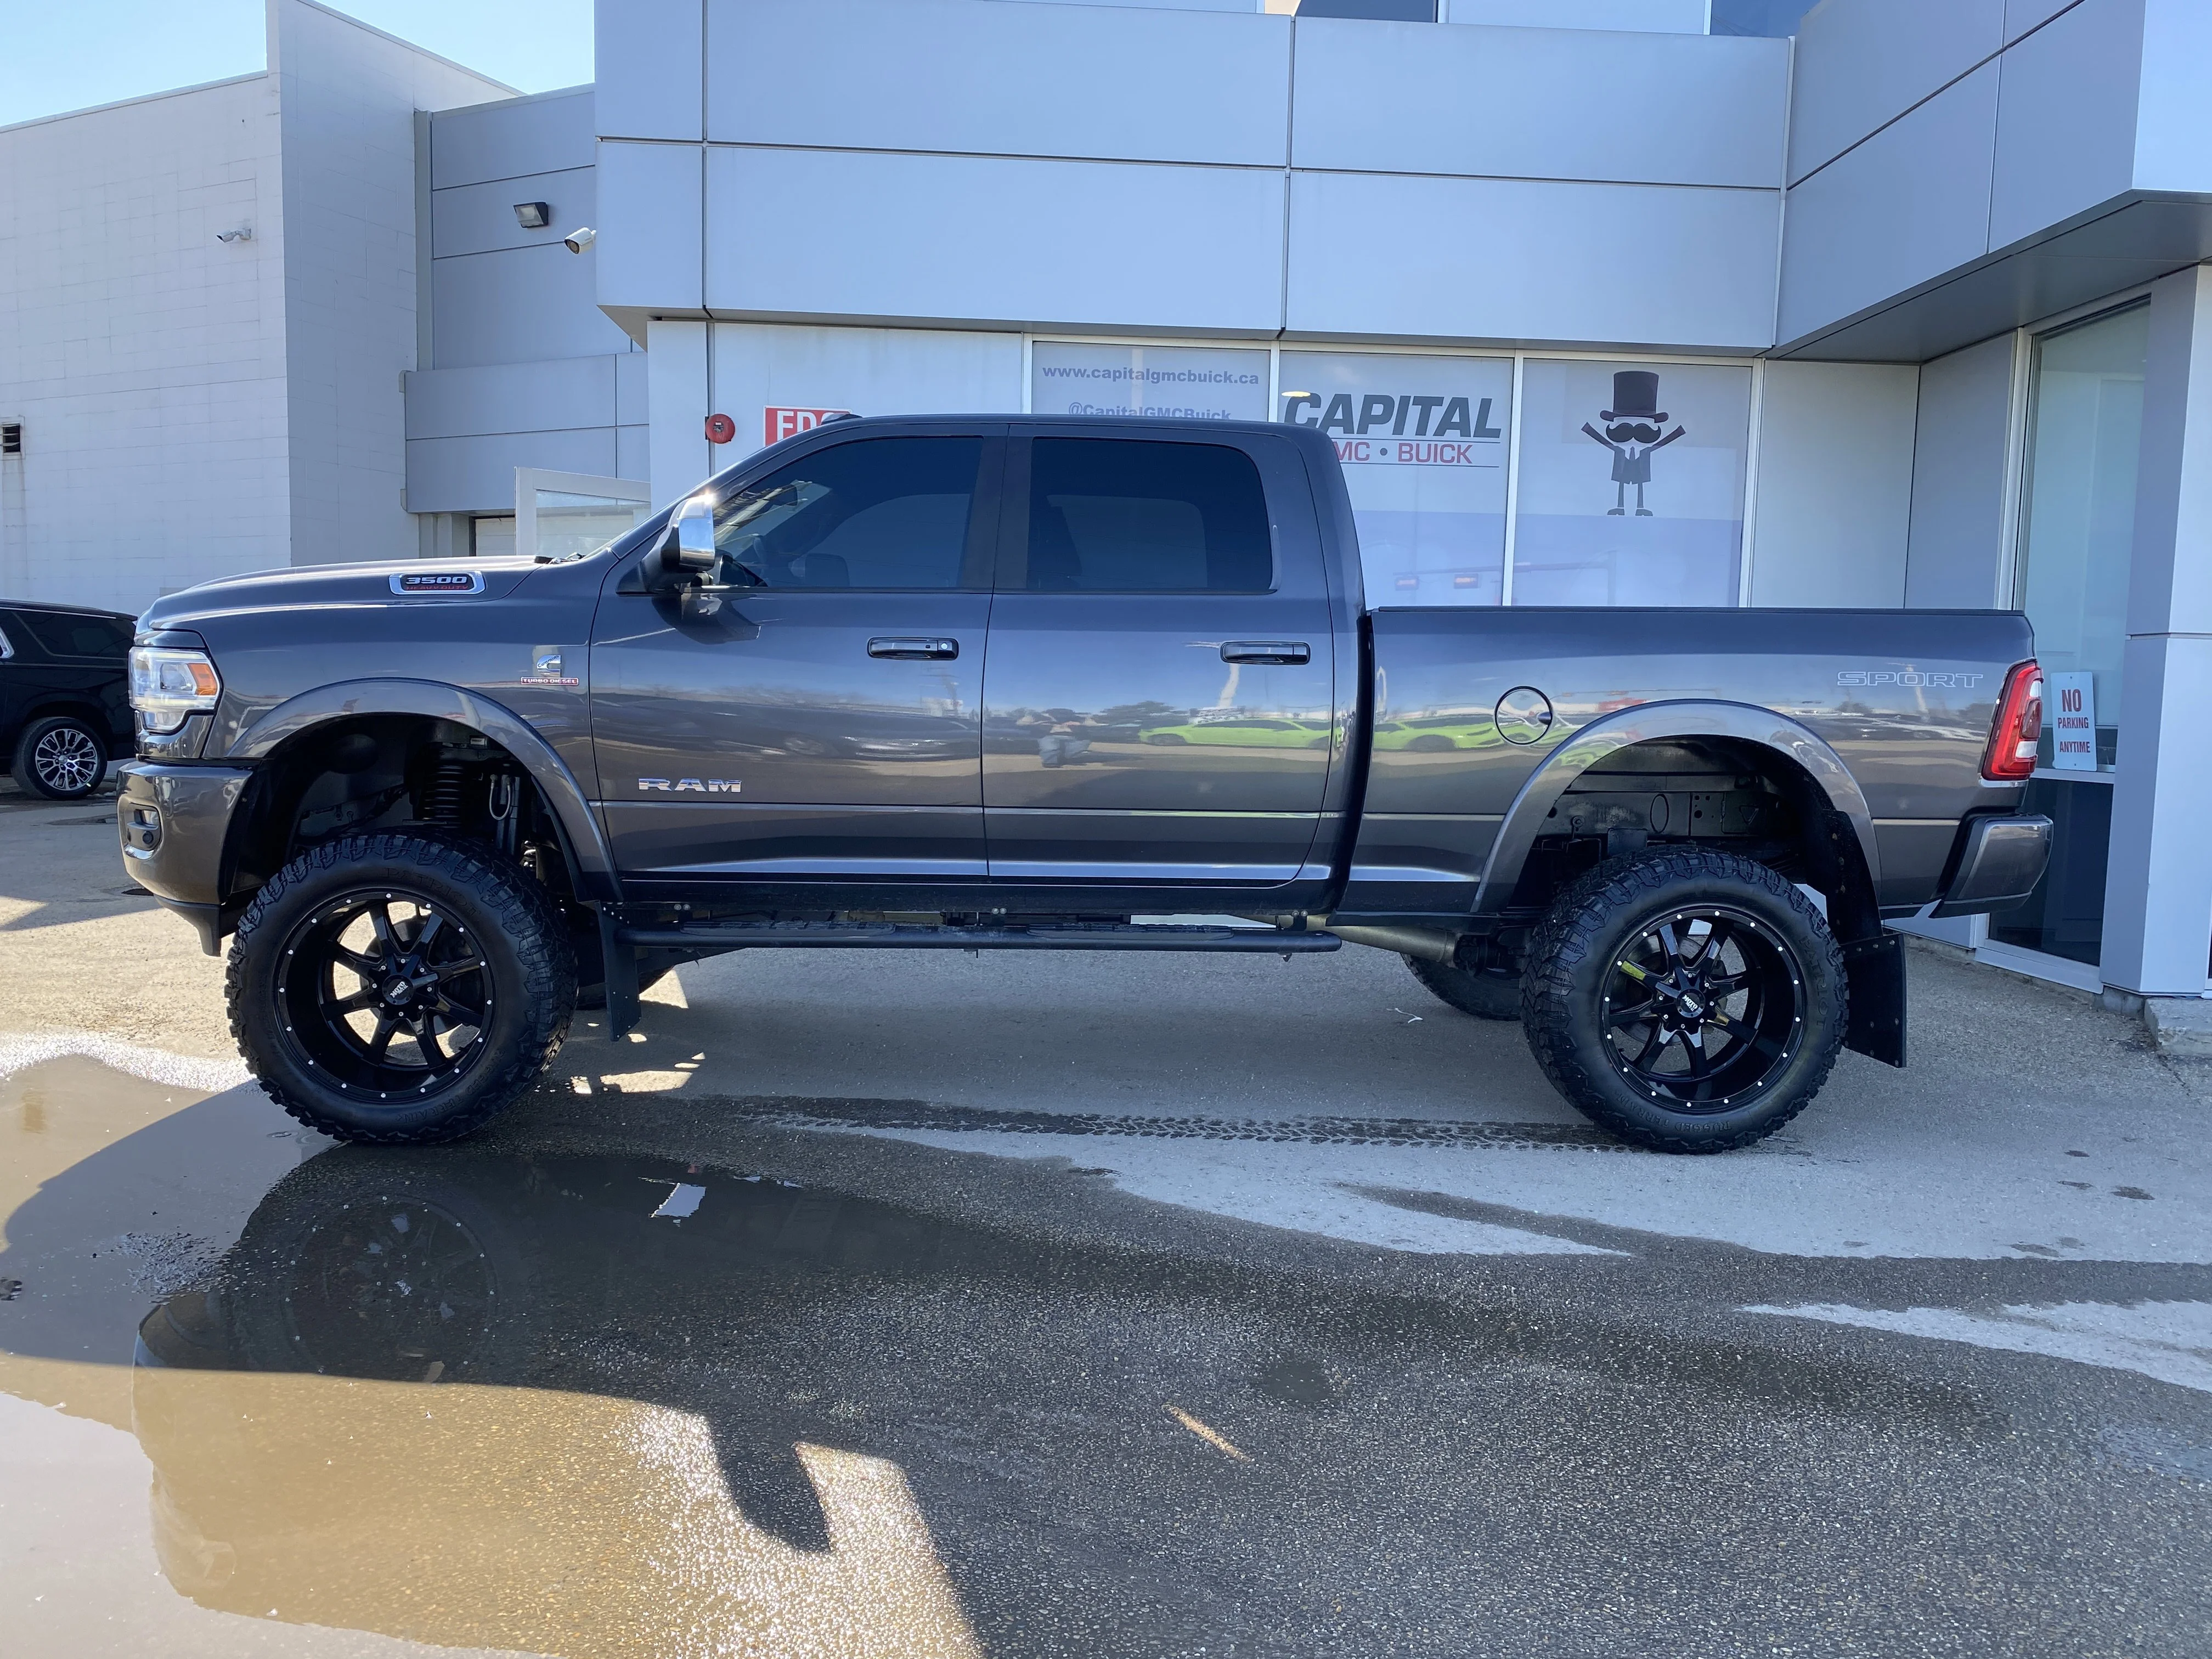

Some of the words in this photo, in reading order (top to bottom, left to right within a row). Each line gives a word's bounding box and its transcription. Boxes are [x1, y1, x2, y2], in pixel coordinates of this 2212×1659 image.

[1042, 367, 1259, 384] www.capitalgmcbuick.ca
[1284, 392, 1502, 438] CAPITAL
[777, 410, 834, 441] FD
[1333, 441, 1370, 461] MC
[1398, 443, 1472, 464] BUICK
[537, 654, 560, 668] Cummins
[1837, 672, 1984, 688] SPORT
[2062, 689, 2082, 712] NO
[2058, 717, 2089, 729] PARKING
[2059, 741, 2091, 753] ANYTIME
[638, 778, 742, 793] RAM
